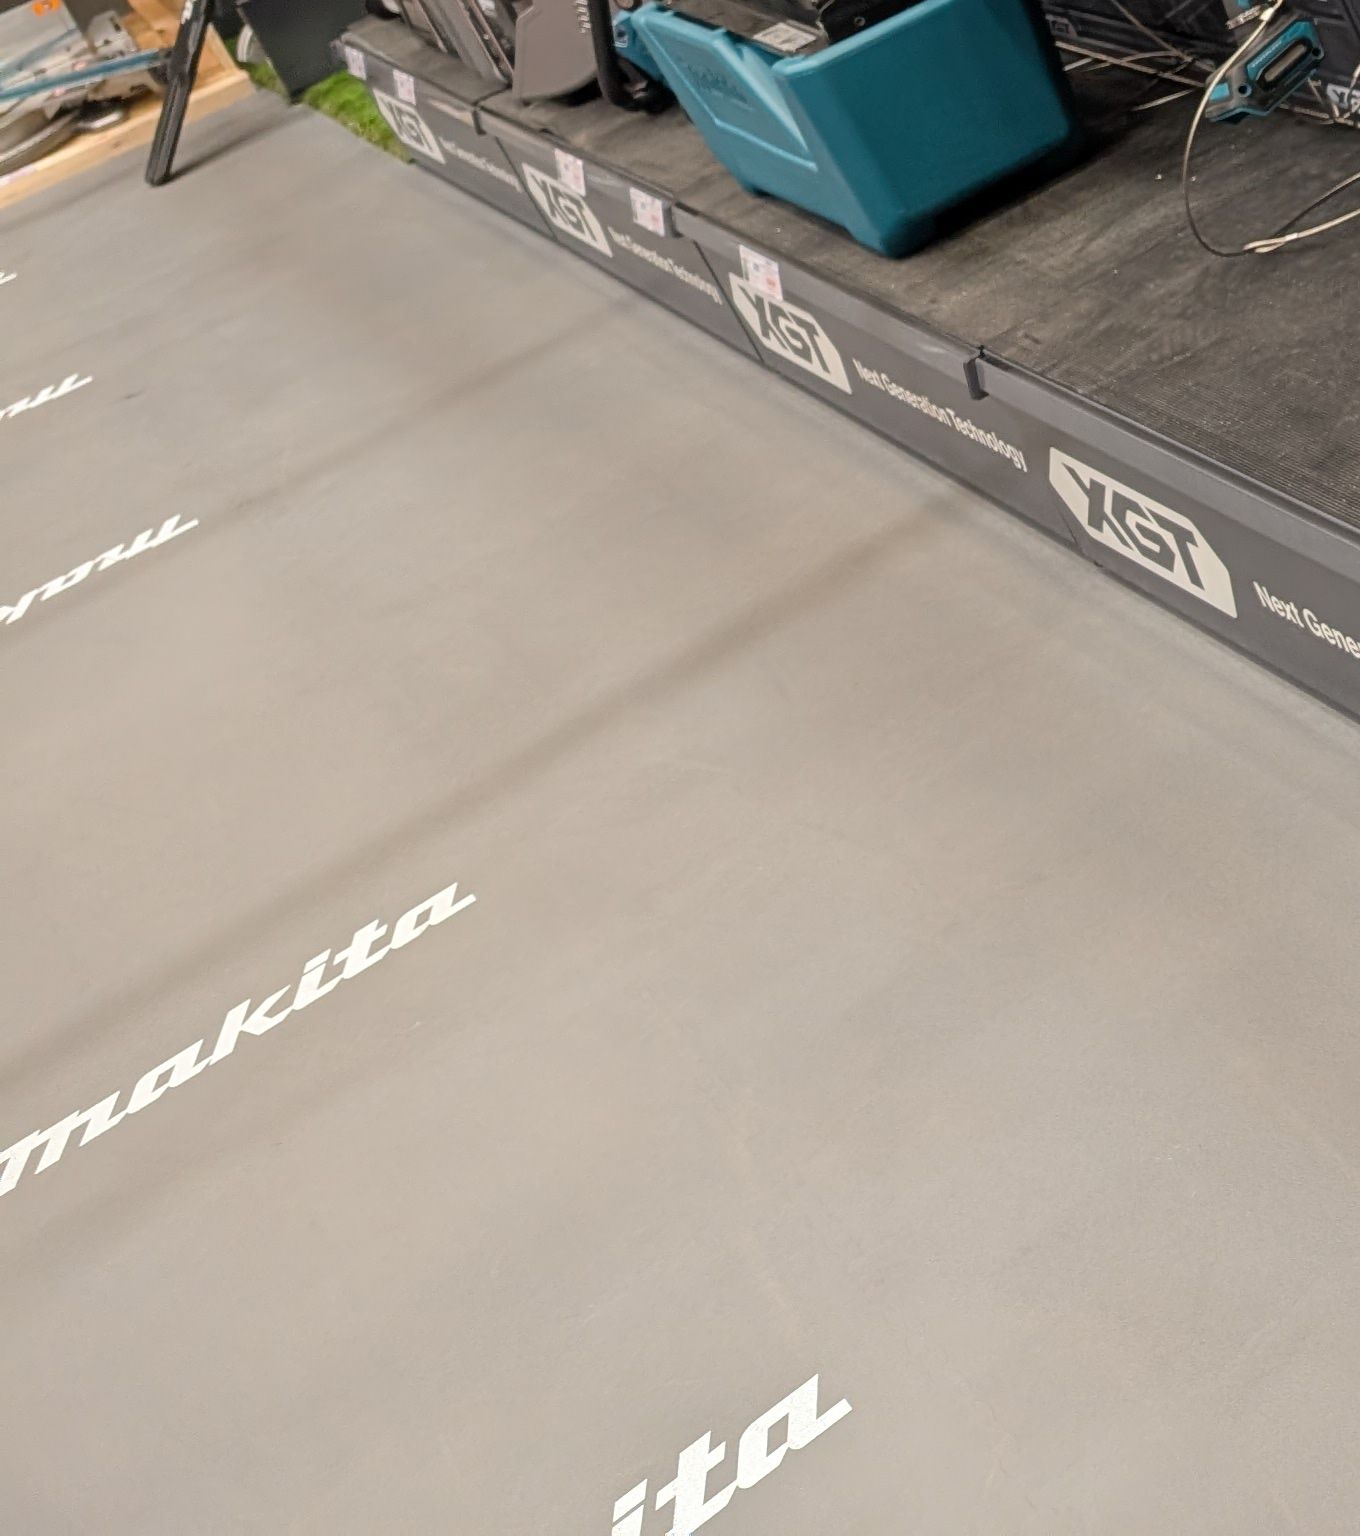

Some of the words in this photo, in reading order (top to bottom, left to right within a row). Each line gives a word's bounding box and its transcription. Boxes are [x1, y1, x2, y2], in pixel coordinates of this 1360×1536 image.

[754, 291, 832, 376] XGT
[852, 358, 885, 392] Next
[883, 372, 950, 428] Generation
[946, 407, 1028, 473] Technology
[1061, 461, 1209, 592] XGT
[1253, 581, 1303, 630] Next
